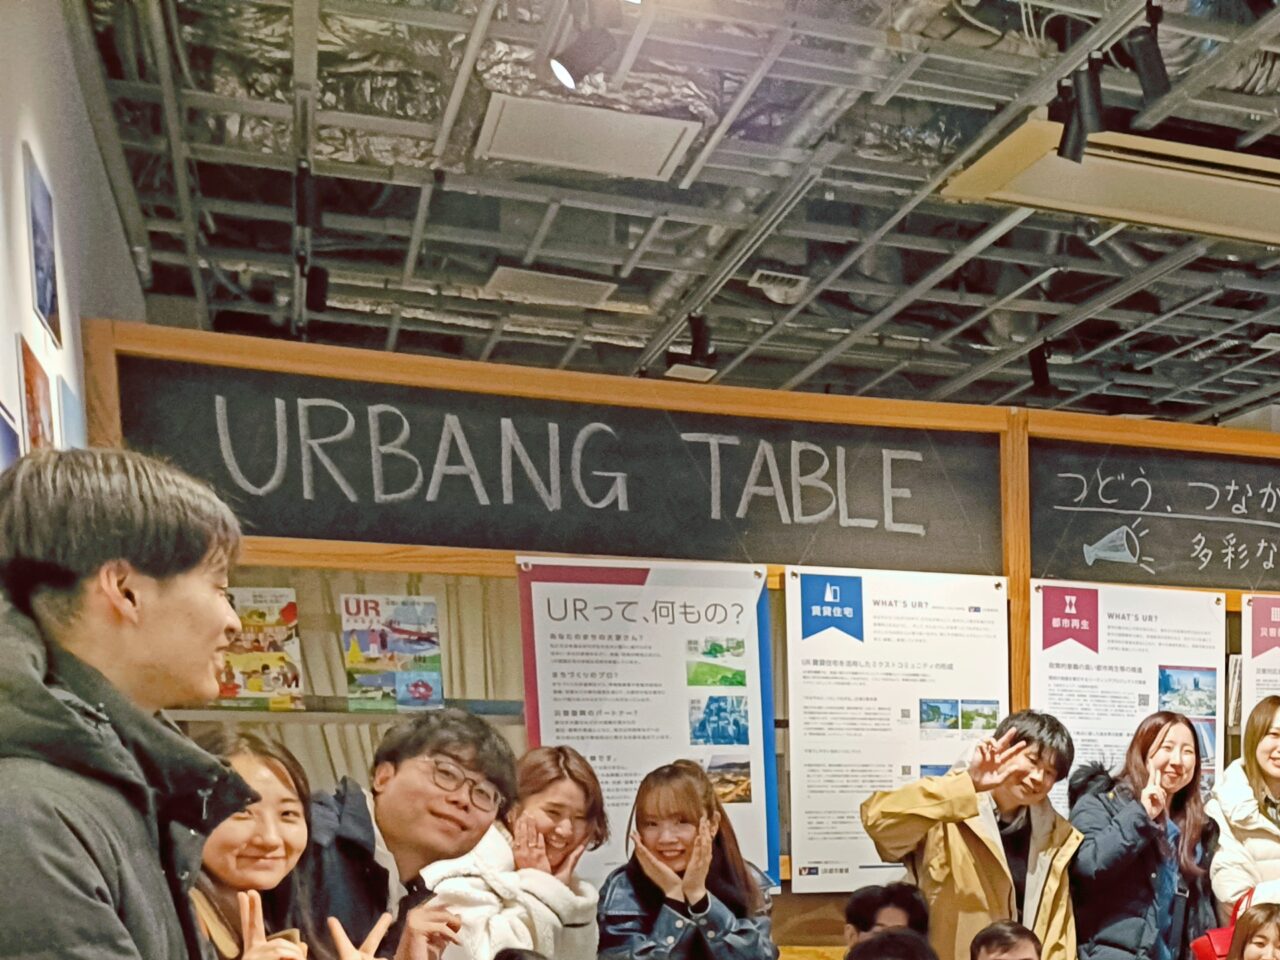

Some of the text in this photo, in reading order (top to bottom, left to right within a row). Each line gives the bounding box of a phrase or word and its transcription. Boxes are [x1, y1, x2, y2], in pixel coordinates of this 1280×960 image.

[215, 395, 926, 537] URBANG TABLE
[344, 597, 380, 617] UR
[872, 599, 908, 609] WHAT'S
[1051, 617, 1090, 630] 都市再生
[1107, 612, 1140, 622] WHAT'S
